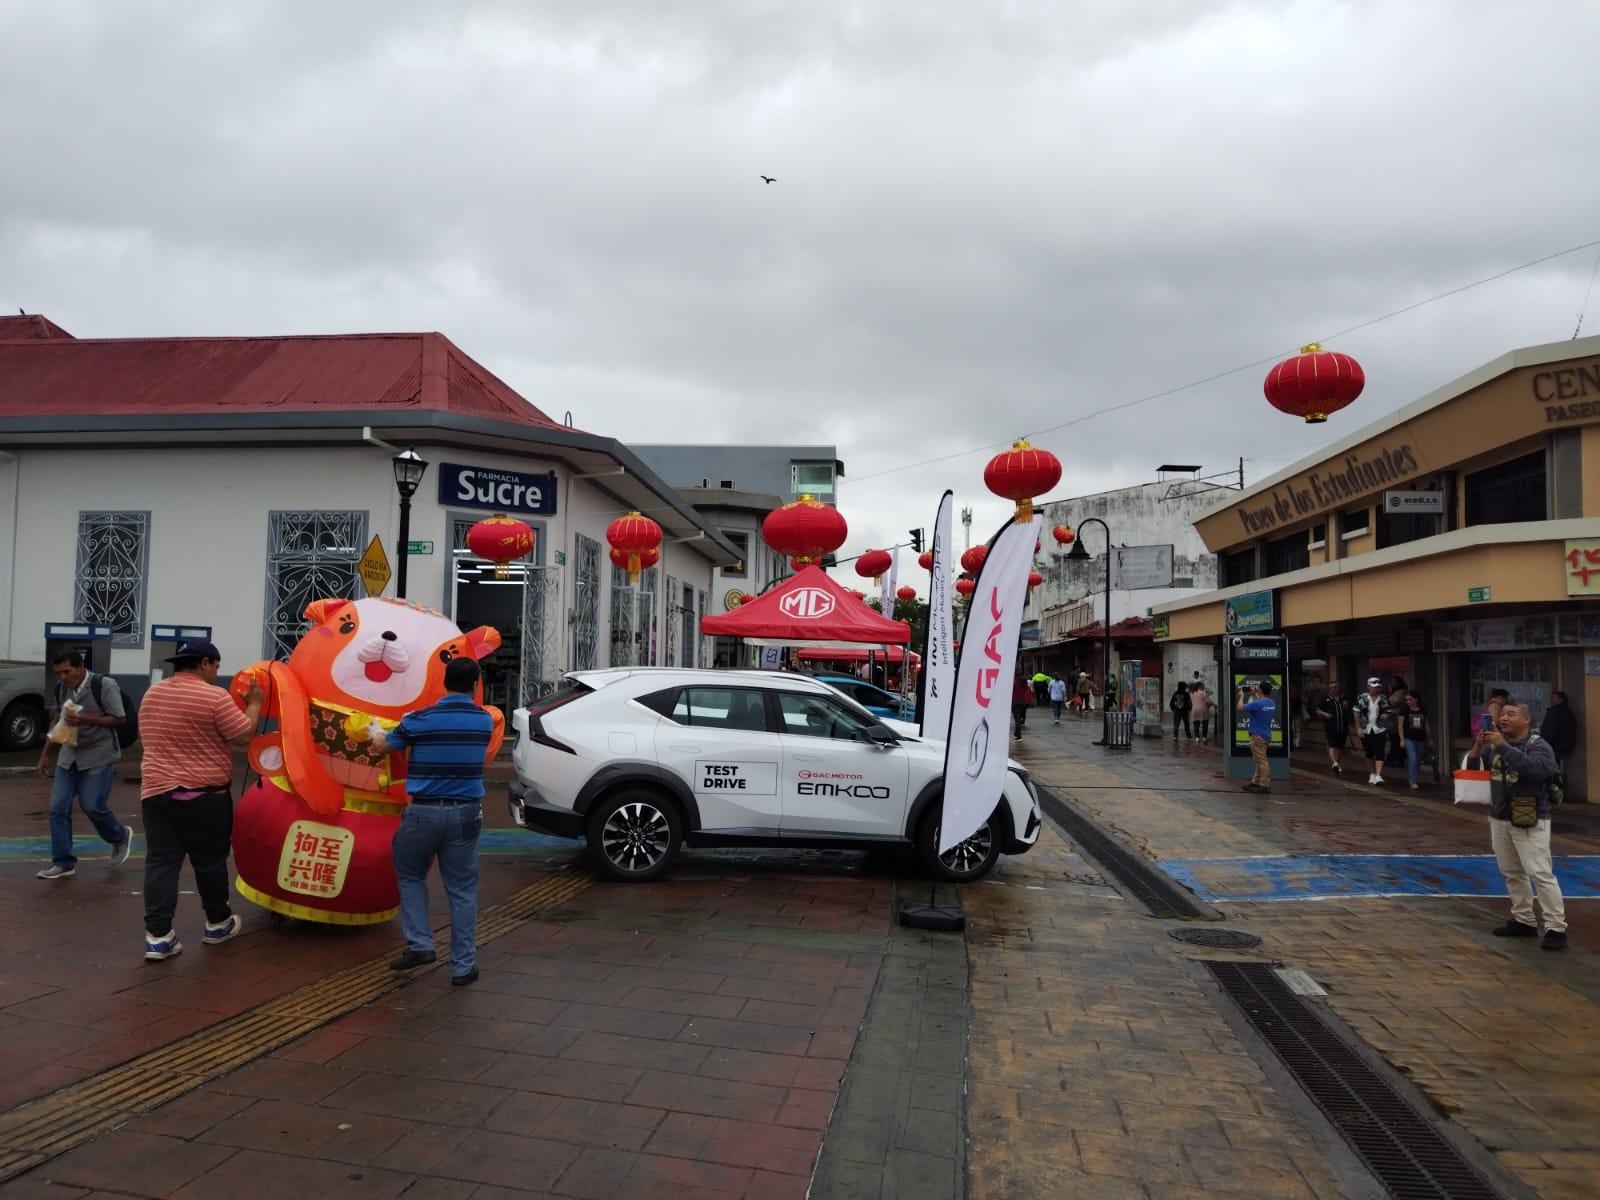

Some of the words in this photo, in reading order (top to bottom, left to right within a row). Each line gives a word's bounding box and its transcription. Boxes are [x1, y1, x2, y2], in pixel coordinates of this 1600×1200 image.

[478, 472, 520, 483] FARMACIA
[457, 470, 542, 508] Sucre
[1238, 505, 1276, 535] Paseo
[1273, 491, 1292, 521] de
[1288, 484, 1315, 515] los
[1309, 444, 1418, 508] Estudiantes
[784, 590, 831, 616] MG
[976, 586, 1004, 709] GAC
[704, 765, 739, 776] TEST
[703, 778, 747, 789] DRIVE
[797, 782, 890, 799] EMKOO
